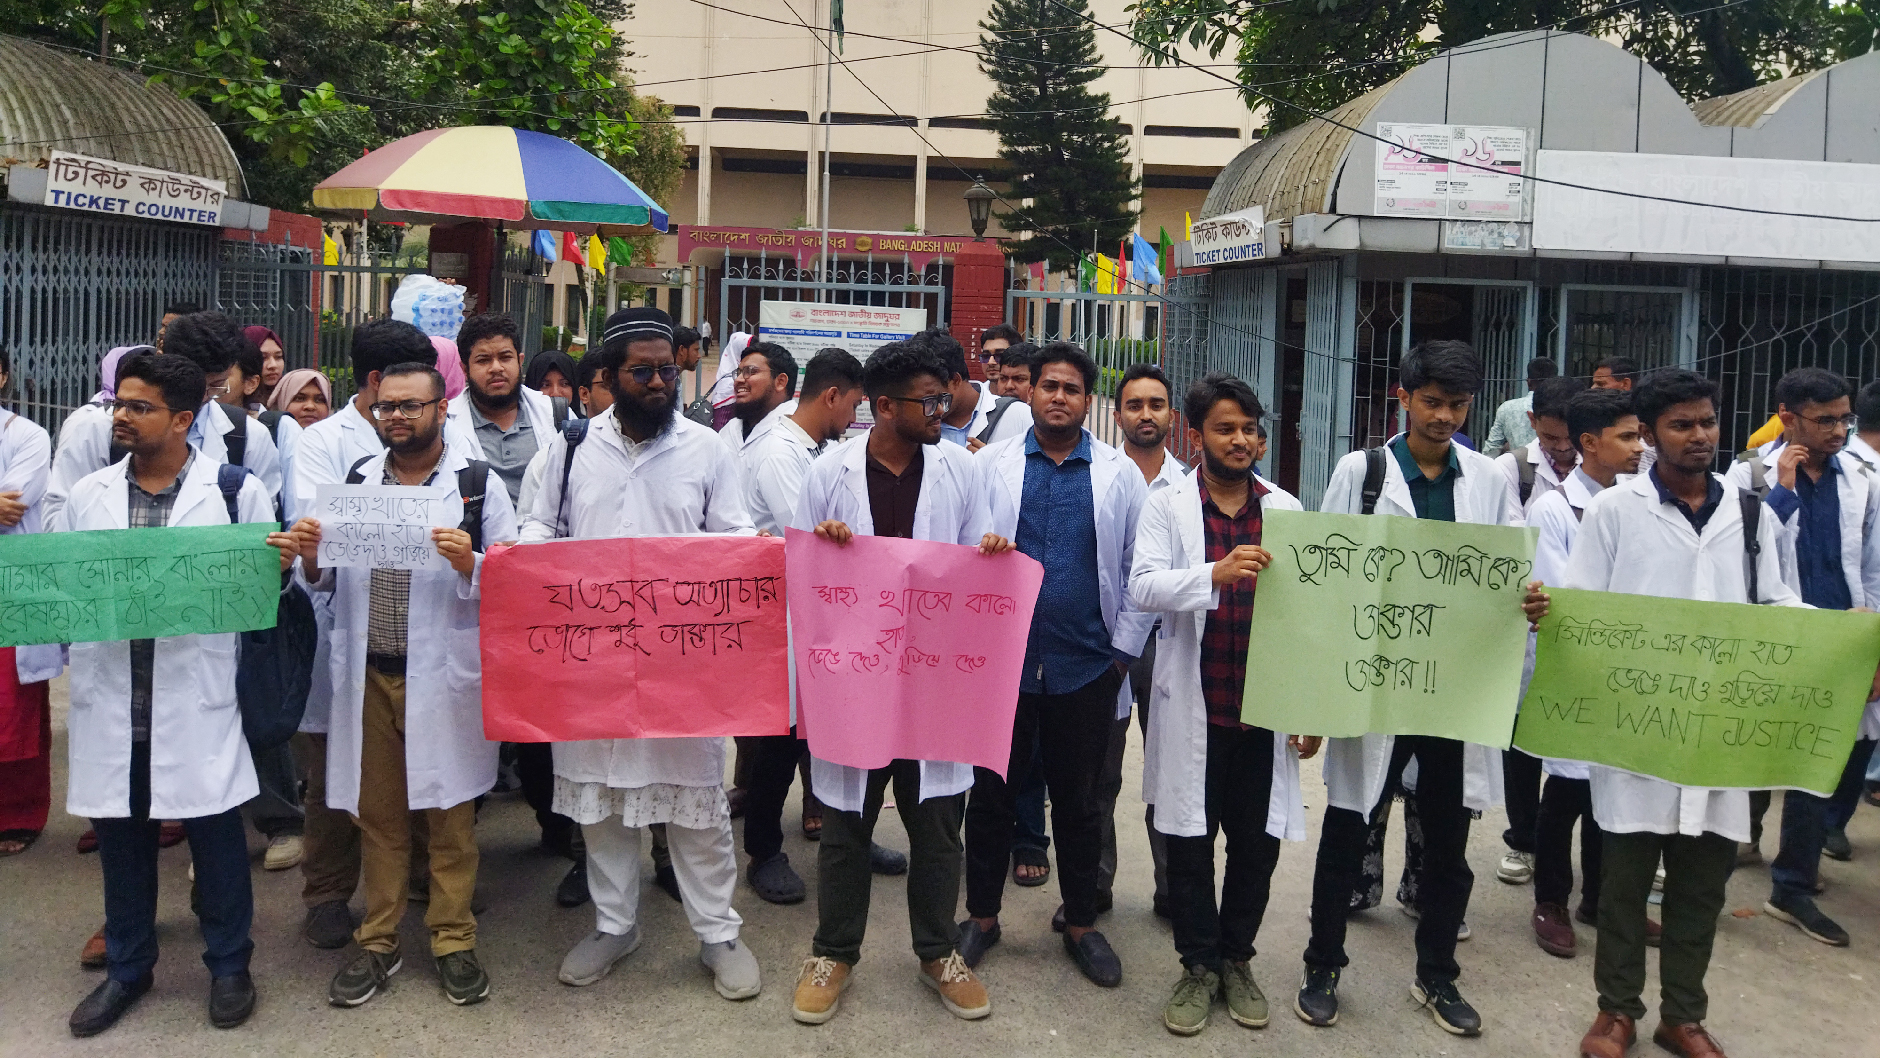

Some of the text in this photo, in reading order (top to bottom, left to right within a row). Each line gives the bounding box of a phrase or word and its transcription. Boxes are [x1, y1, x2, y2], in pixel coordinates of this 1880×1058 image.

[52, 157, 223, 206] টিকিট কাউন্টার
[51, 189, 217, 223] TICKET COUNTER
[689, 230, 750, 245] বাংলাদেশ
[755, 230, 796, 247] জাতীয়
[879, 239, 941, 253] BANGLADESH
[1190, 221, 1217, 246] টিকিট
[1195, 242, 1264, 264] TICKET COUNTER
[811, 309, 901, 322] বাংলাদেশ জাতীয় জাদুঘর
[371, 496, 439, 523] খাতের
[334, 522, 437, 546] কালো হাত
[75, 555, 157, 589] সোনার
[170, 548, 274, 583] বাংলায়
[1288, 533, 1533, 592] তুমি কে? আমি কে?
[673, 575, 782, 617] অত্যাচার
[964, 593, 1017, 616] কালো
[657, 620, 753, 656] ডাক্তার
[1352, 603, 1446, 640] ডাক্তার
[1554, 615, 1801, 666] সিন্ডিকেট এর কালো হাত
[1668, 672, 1712, 702] দাও
[1789, 684, 1834, 711] দাও
[1540, 696, 1842, 760] WE WANT JUSTICE
